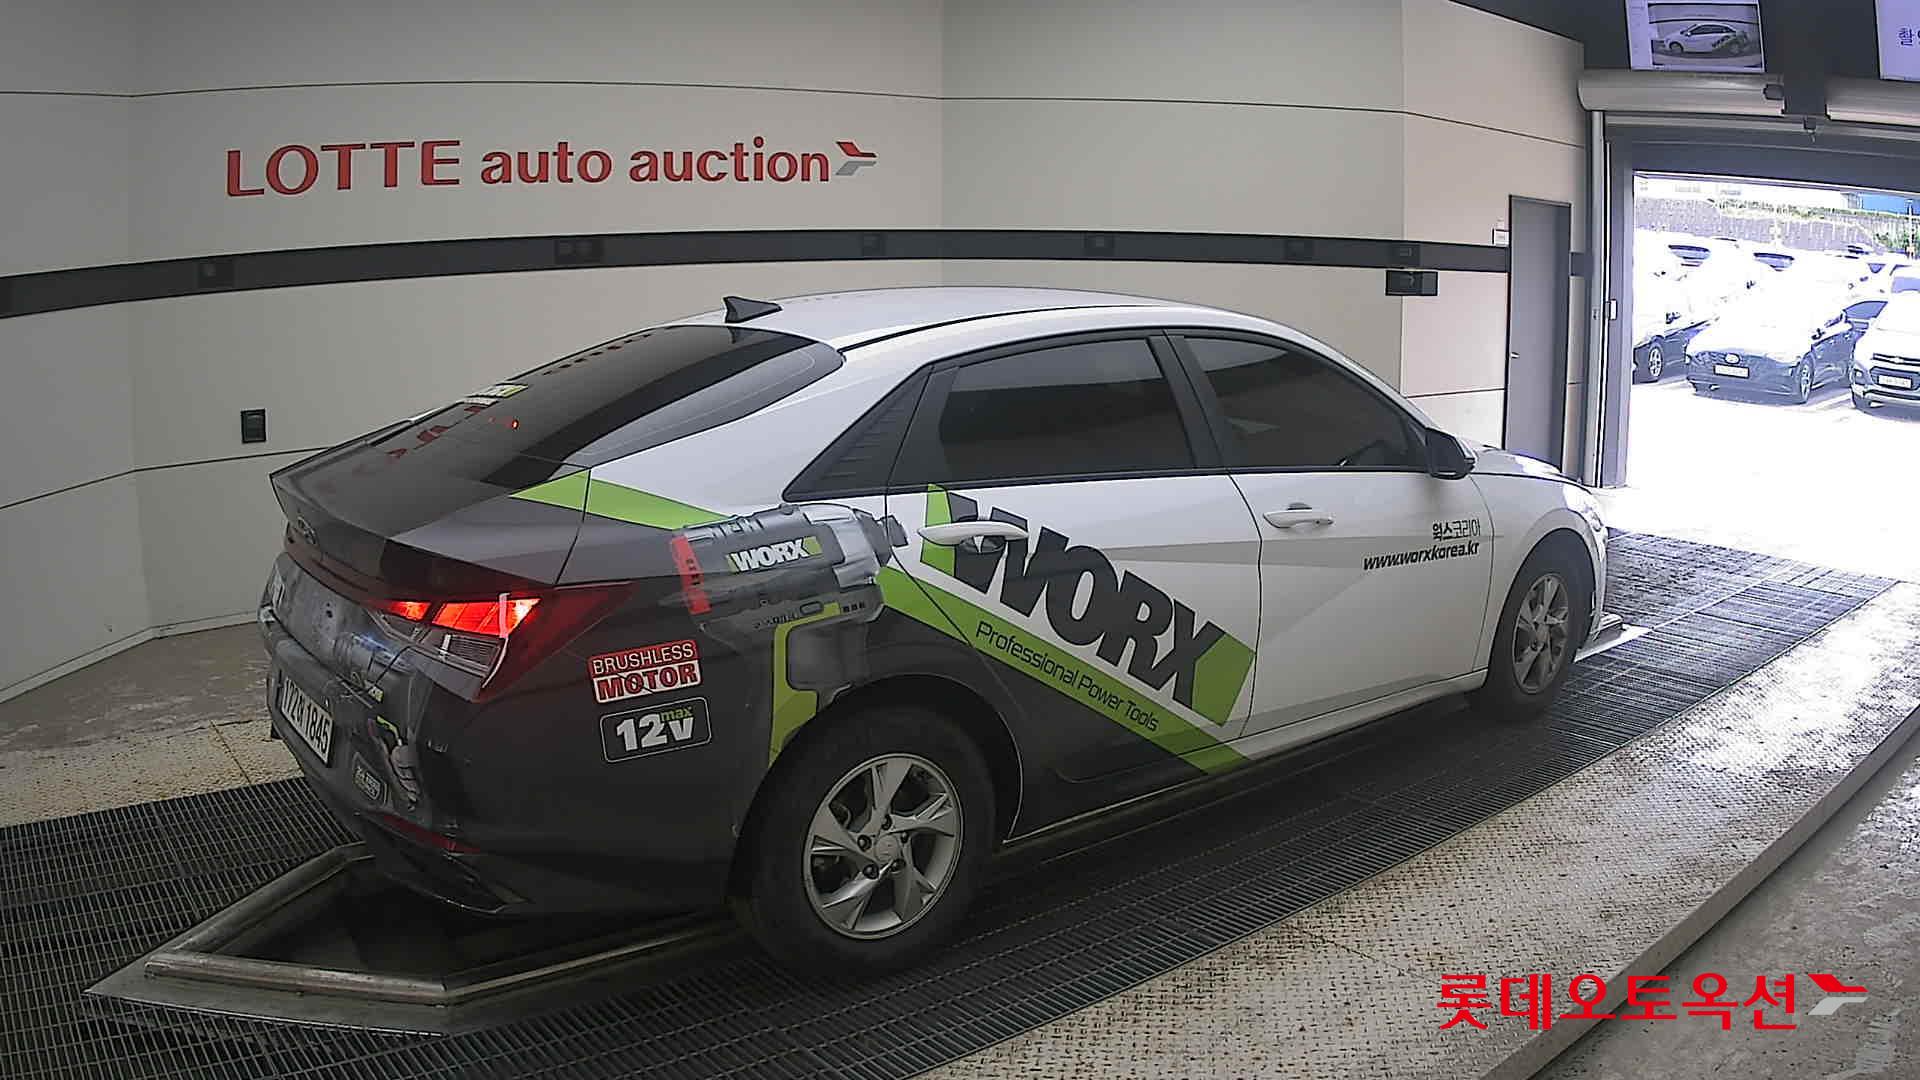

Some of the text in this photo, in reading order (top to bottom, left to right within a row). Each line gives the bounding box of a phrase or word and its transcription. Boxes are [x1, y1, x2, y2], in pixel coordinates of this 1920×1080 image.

[227, 136, 830, 198] LOTTE auto auction
[1432, 519, 1480, 541] 웍스코리아
[731, 538, 809, 572] WORX
[1363, 540, 1480, 570] www.worxkorea.kr
[949, 491, 1226, 711] WORX
[592, 642, 694, 675] BRUSHLESS
[975, 620, 1160, 733] Professional Power Tools
[597, 662, 698, 700] MOTOR
